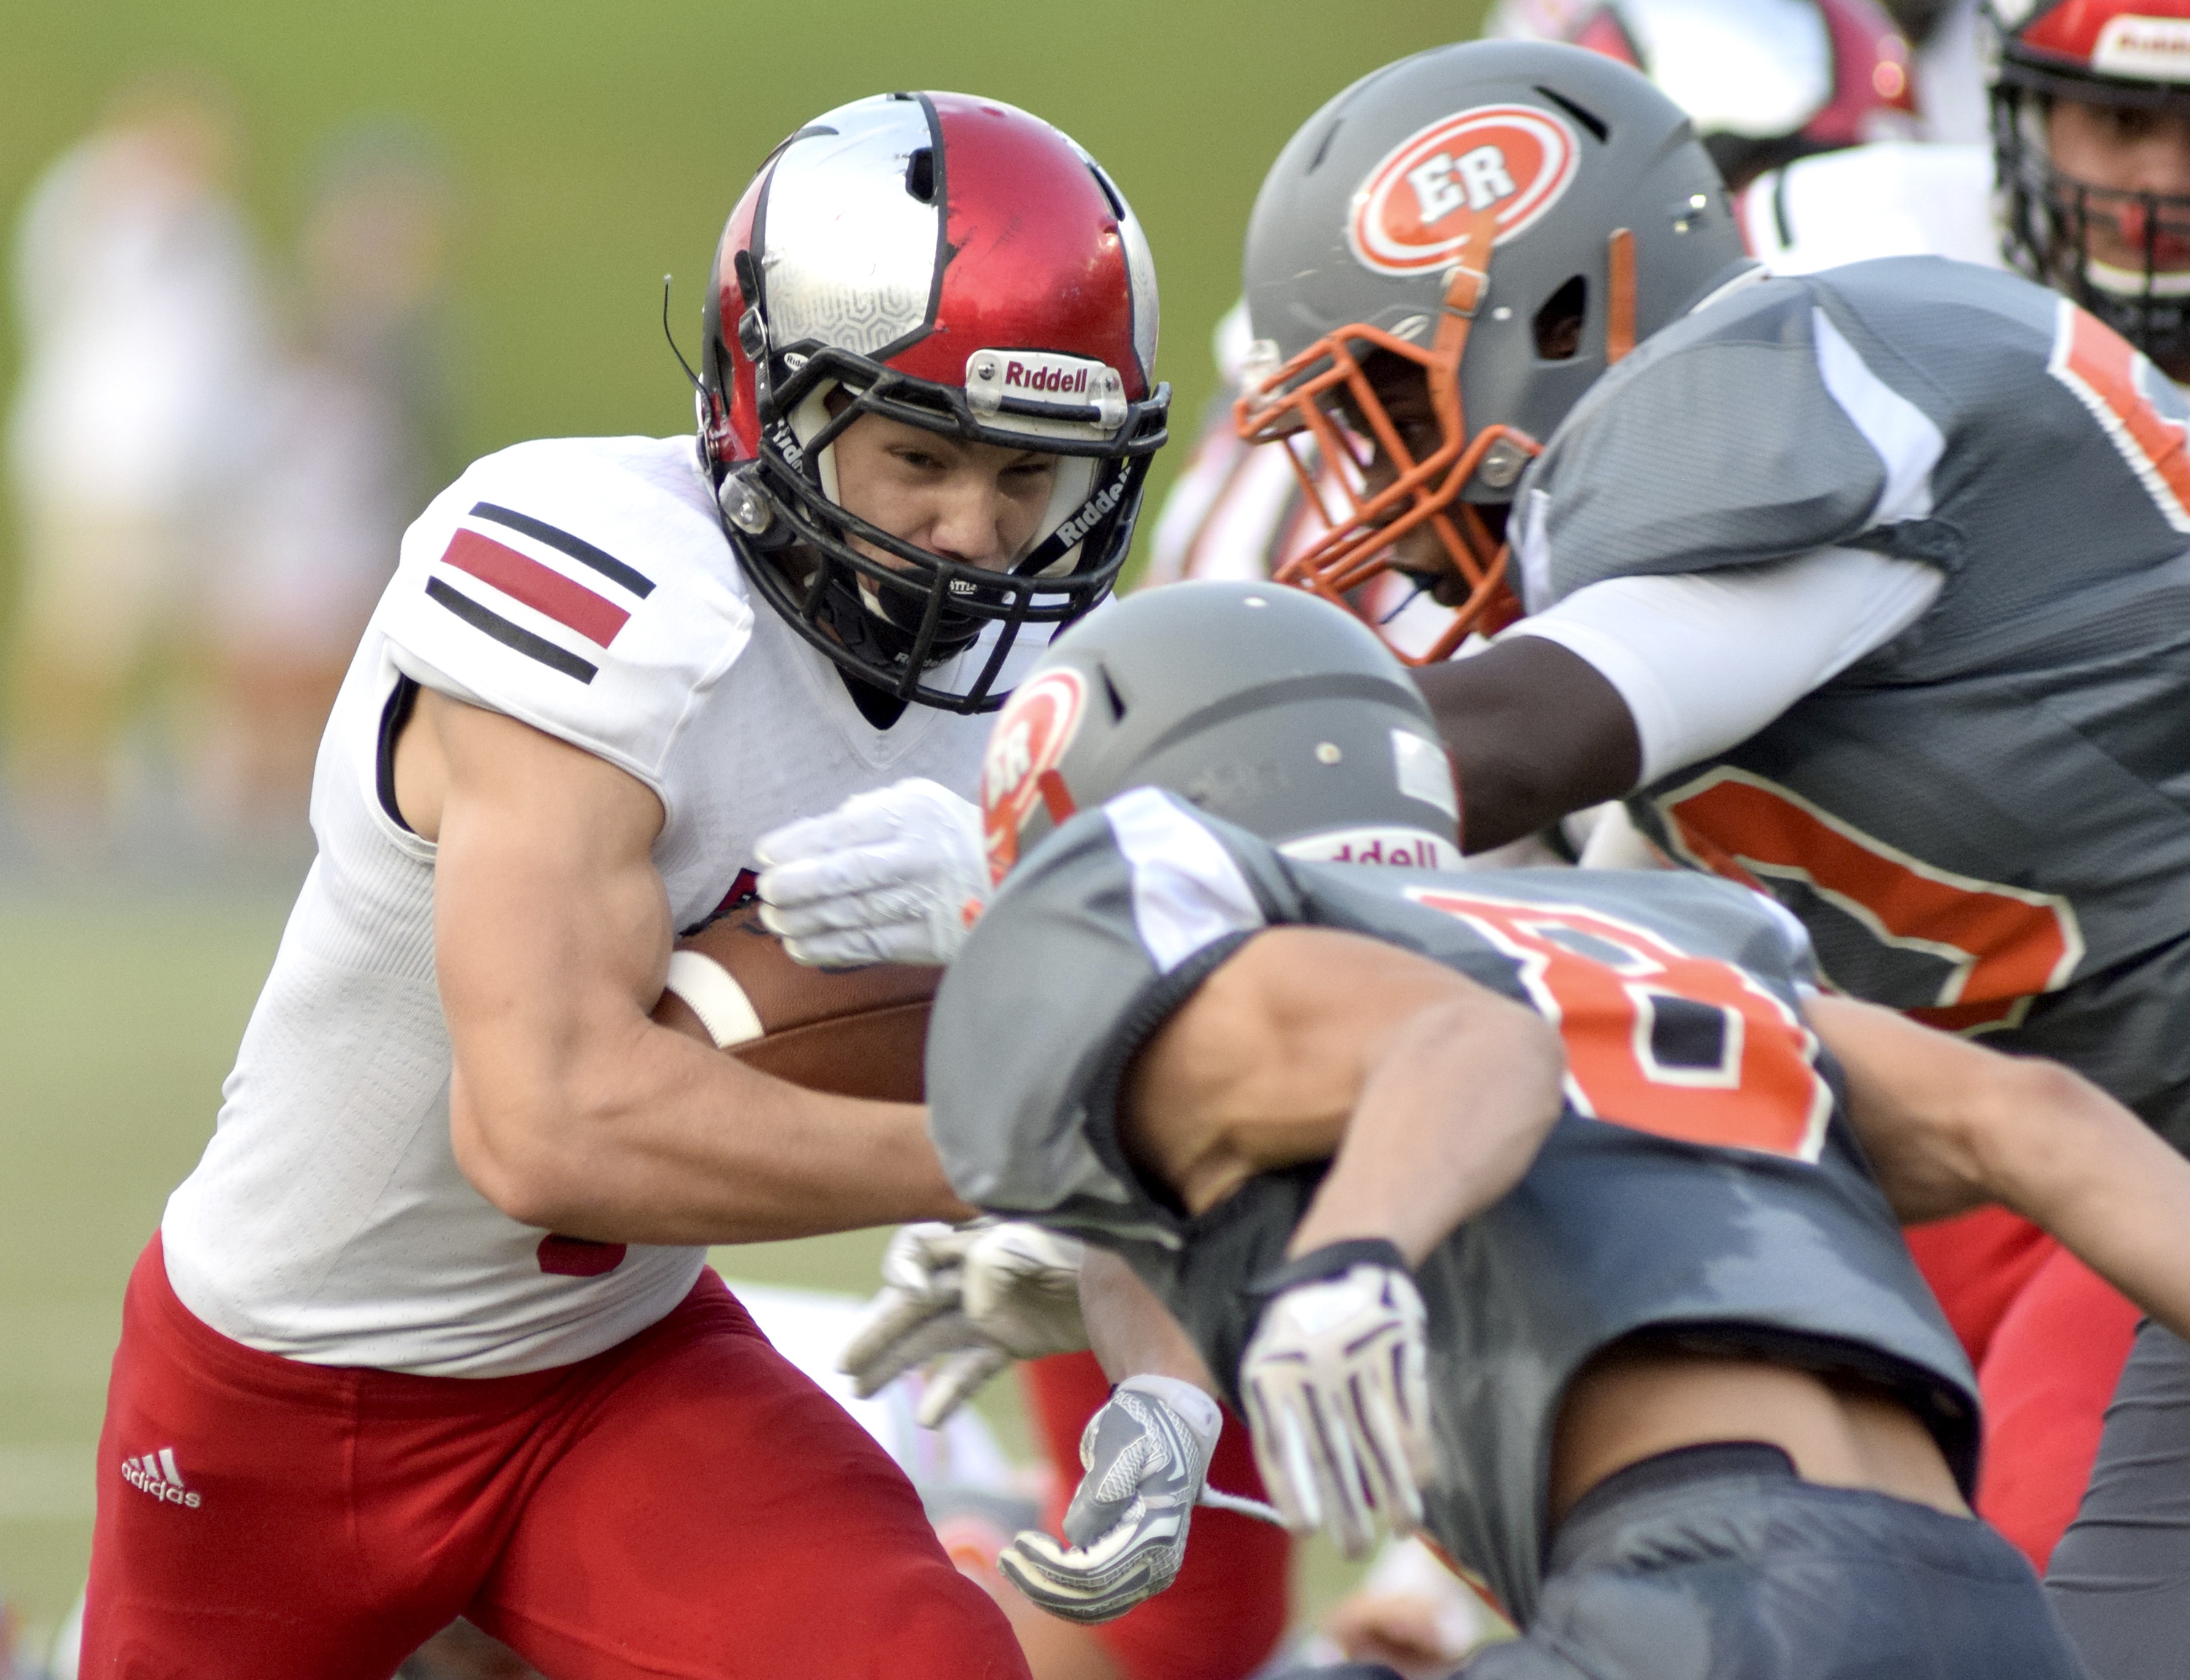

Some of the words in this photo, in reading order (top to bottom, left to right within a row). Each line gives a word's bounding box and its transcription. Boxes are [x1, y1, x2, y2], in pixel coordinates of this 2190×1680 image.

[1406, 145, 1515, 226] ER
[1005, 361, 1088, 393] Riddell
[121, 1461, 201, 1508] adidas
